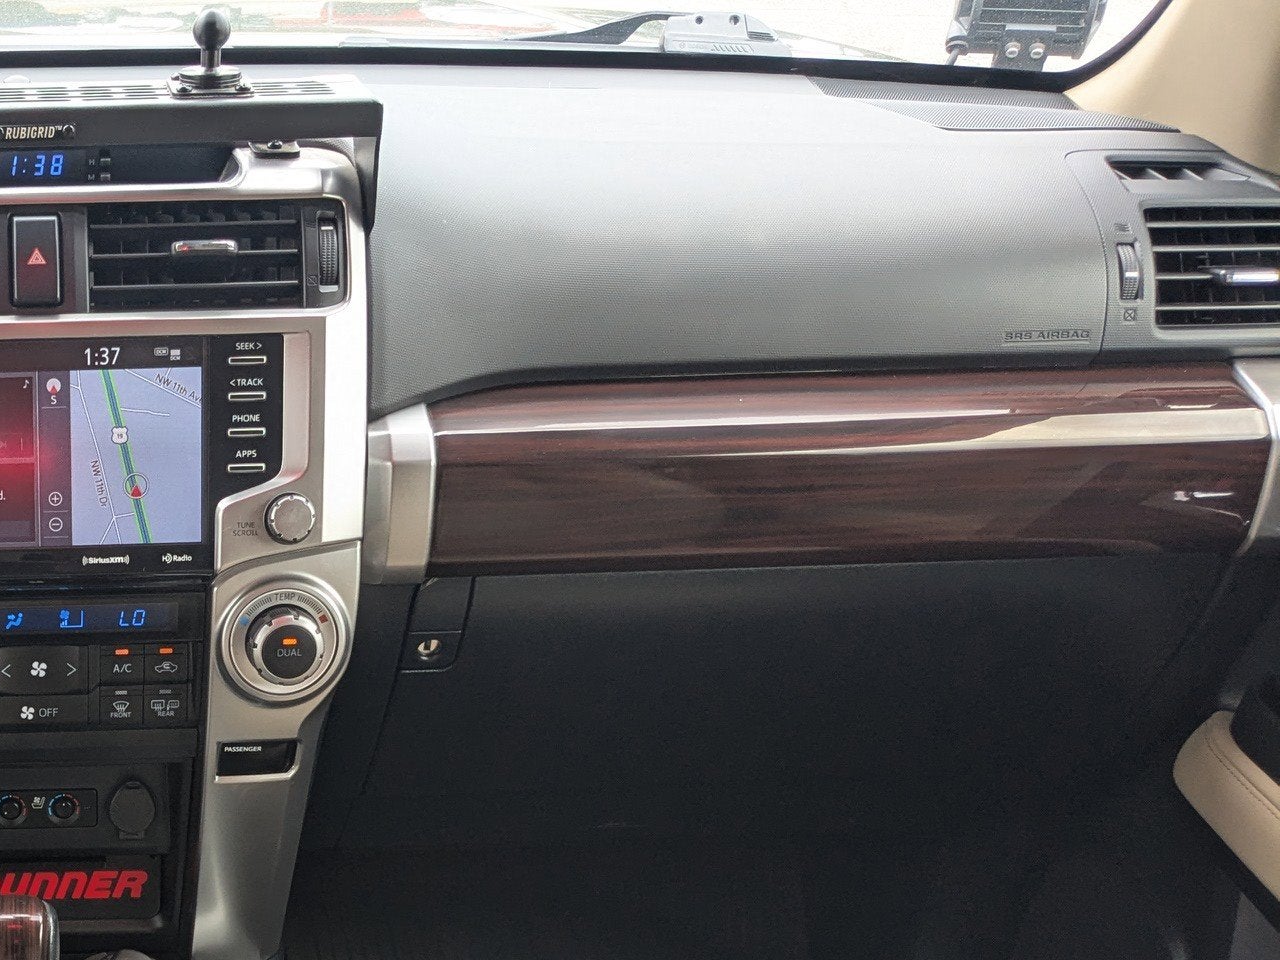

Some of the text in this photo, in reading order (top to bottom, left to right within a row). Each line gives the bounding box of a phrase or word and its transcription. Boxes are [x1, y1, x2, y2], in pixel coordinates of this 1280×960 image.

[11, 154, 64, 176] 1:38
[1004, 330, 1091, 340] SRS AIRBAG
[235, 342, 255, 350] SEEK
[84, 347, 120, 366] 1:37
[155, 373, 173, 387] NW
[172, 382, 188, 396] 11th
[236, 378, 263, 386] TRACK
[50, 395, 57, 405] S
[232, 414, 260, 422] PHONE
[235, 450, 257, 458] APPS
[91, 460, 108, 507] NW 11th Dr
[237, 521, 255, 529] TUNE
[232, 529, 258, 537] SCROLL
[274, 592, 296, 601] TEMP
[119, 609, 146, 627] LO
[277, 649, 302, 657] DUAL
[113, 663, 132, 673] A/C
[38, 707, 59, 718] OFF
